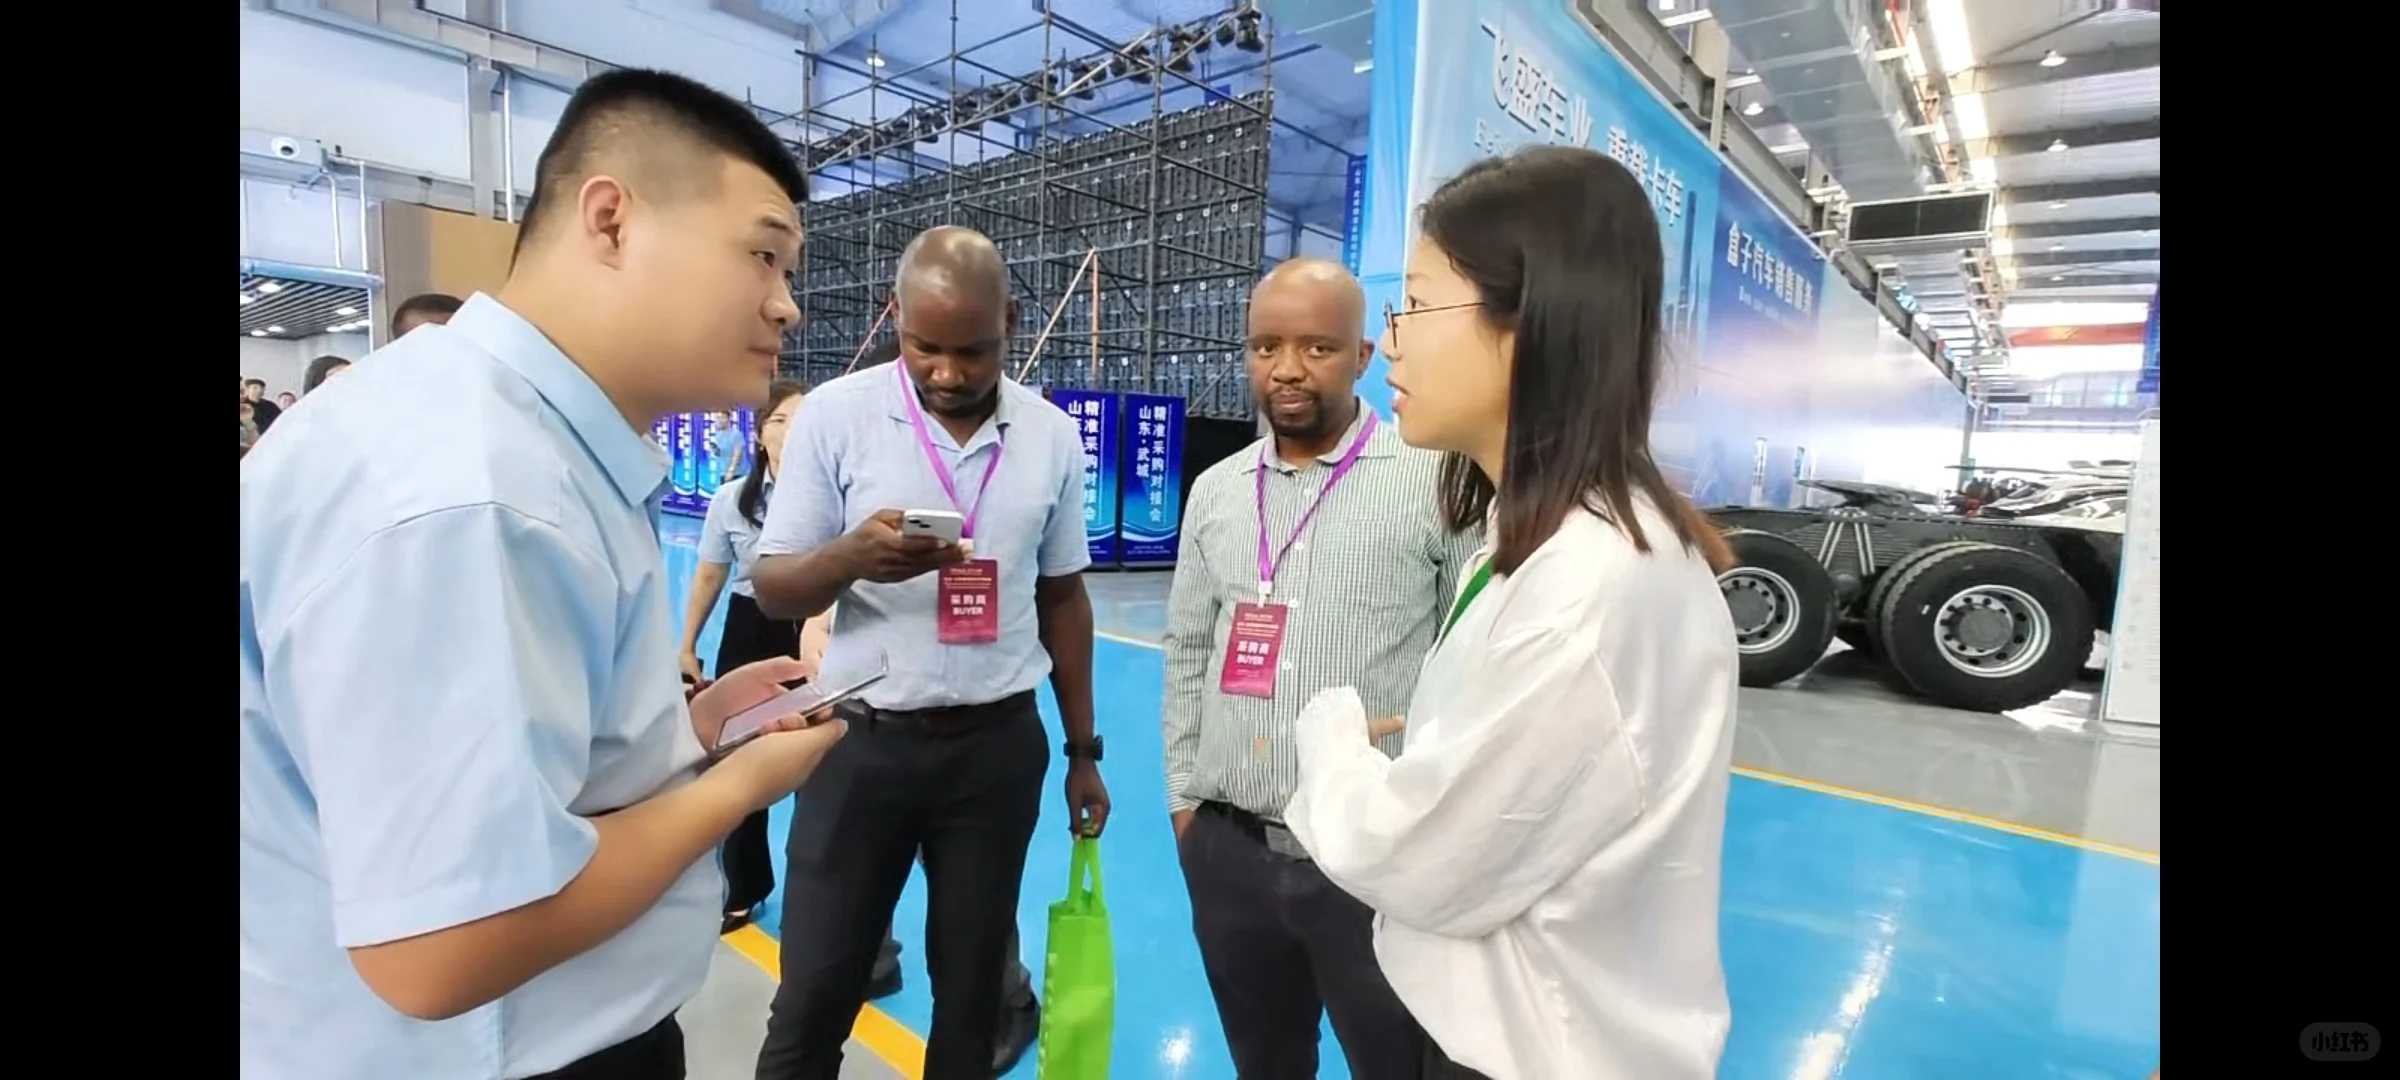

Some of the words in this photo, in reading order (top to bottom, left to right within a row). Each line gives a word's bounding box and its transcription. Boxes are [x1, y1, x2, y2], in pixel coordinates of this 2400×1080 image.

[1149, 406, 1167, 522] 精准采购对接会
[953, 607, 983, 616] BUYER
[1236, 653, 1265, 666] BUYER
